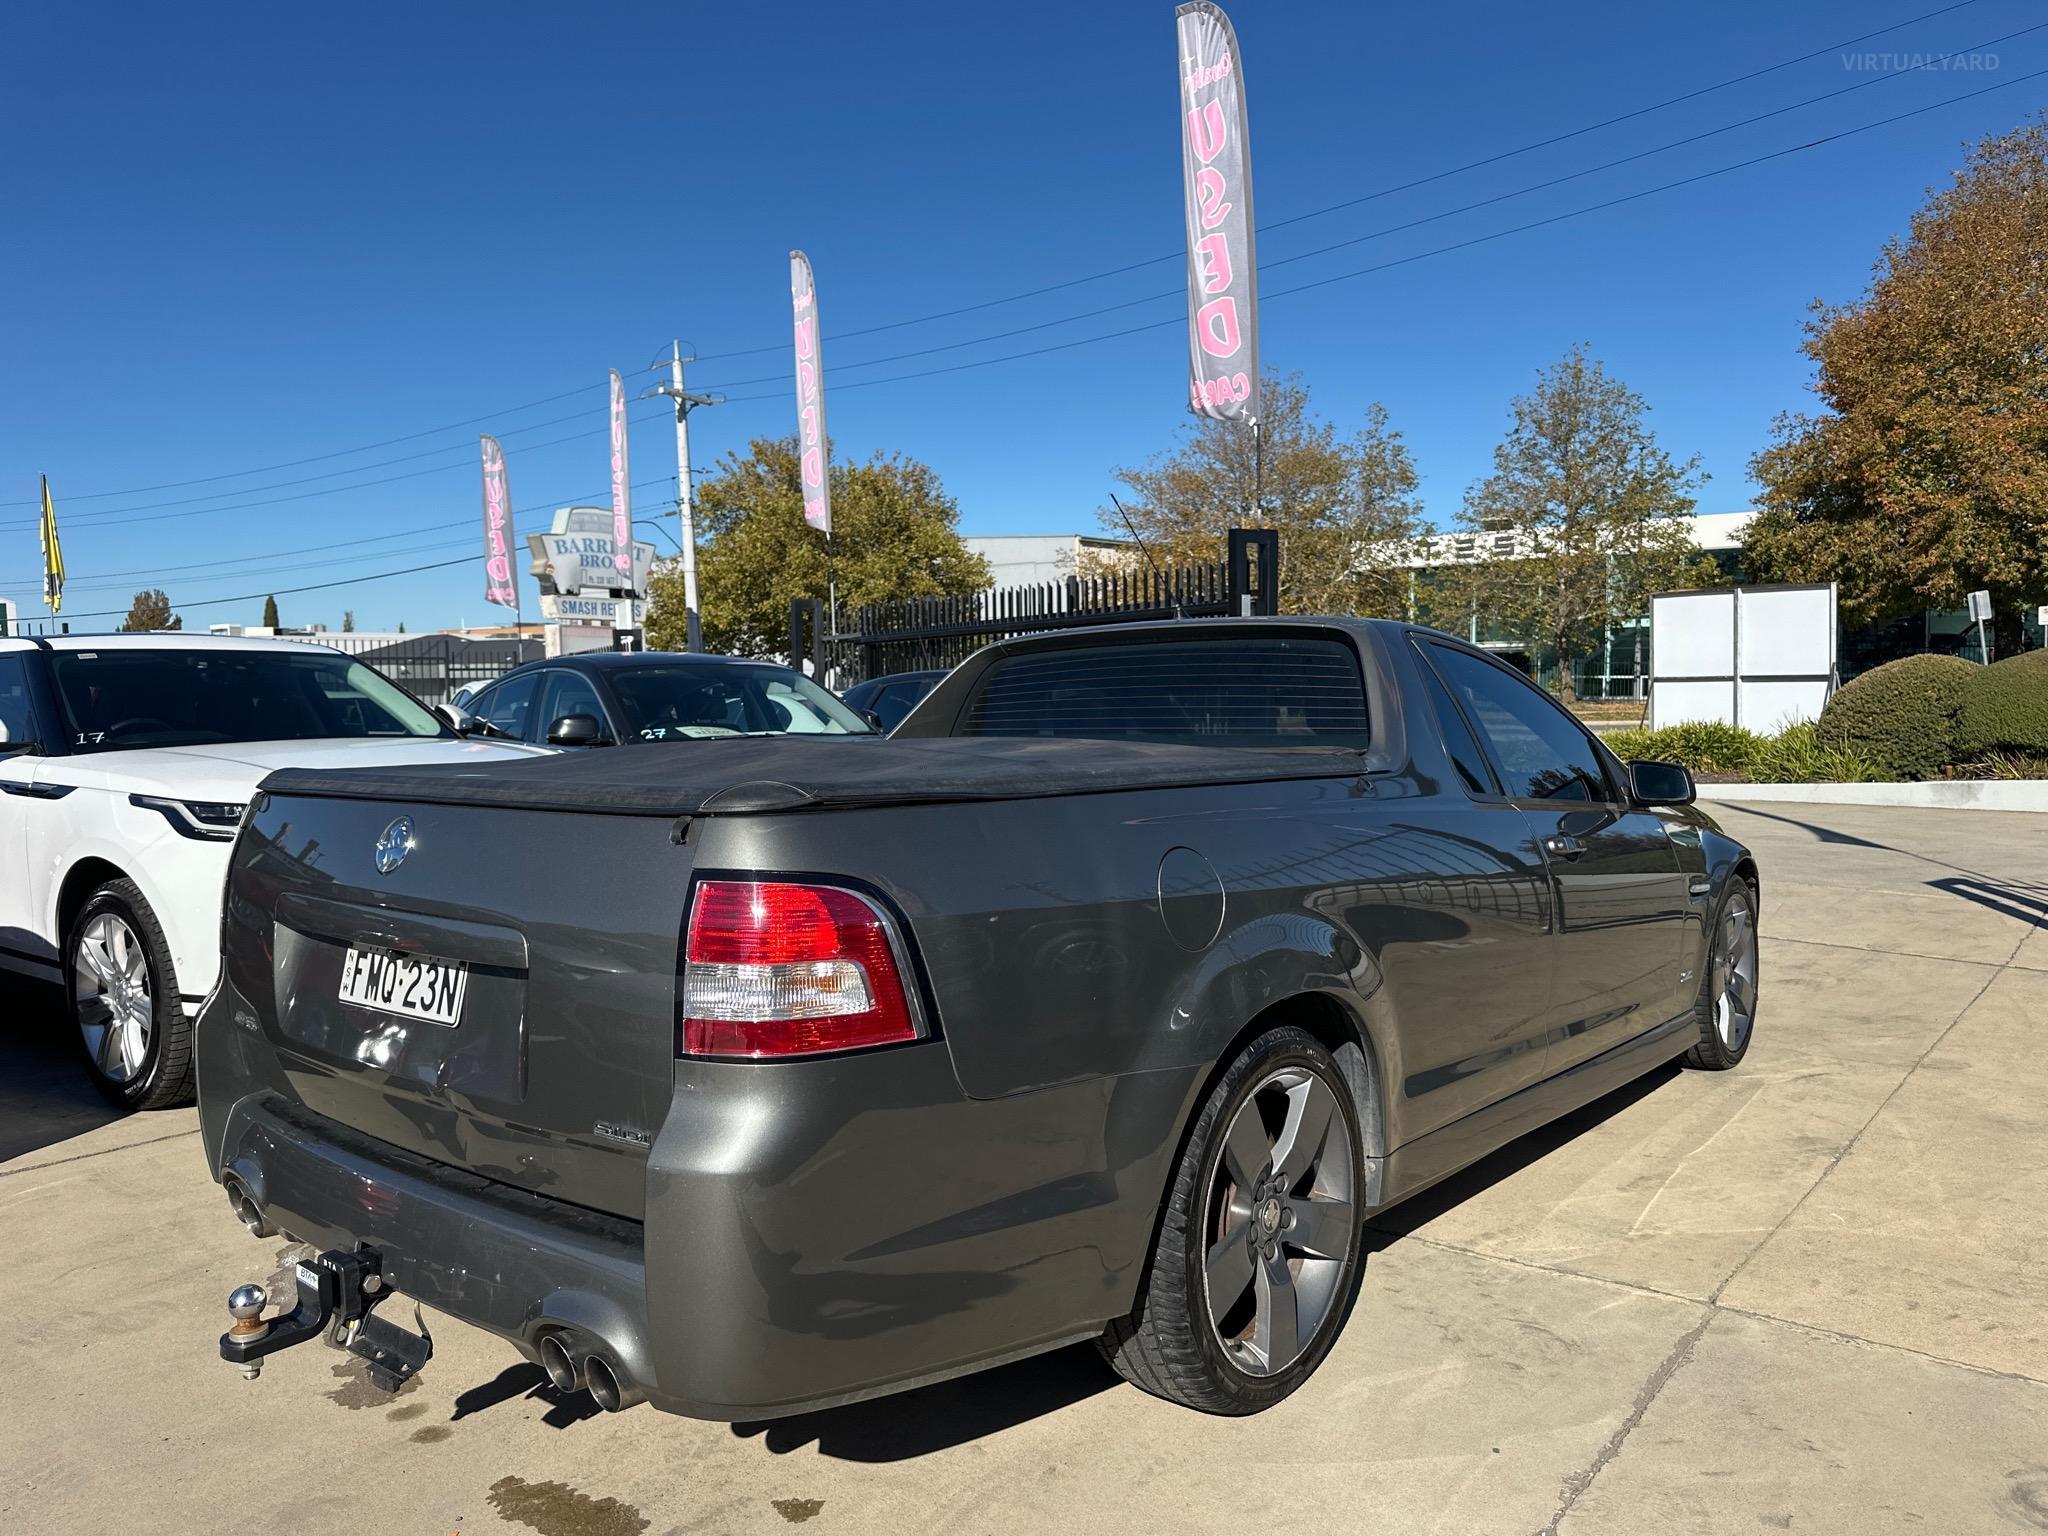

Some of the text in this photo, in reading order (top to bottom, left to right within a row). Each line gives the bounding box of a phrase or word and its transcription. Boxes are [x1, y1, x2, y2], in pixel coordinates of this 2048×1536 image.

[554, 538, 645, 561] BARRT
[1419, 535, 1570, 560] TESL
[580, 554, 613, 568] BRO
[561, 601, 598, 616] SMASH
[76, 732, 105, 744] 17
[640, 728, 666, 739] 27
